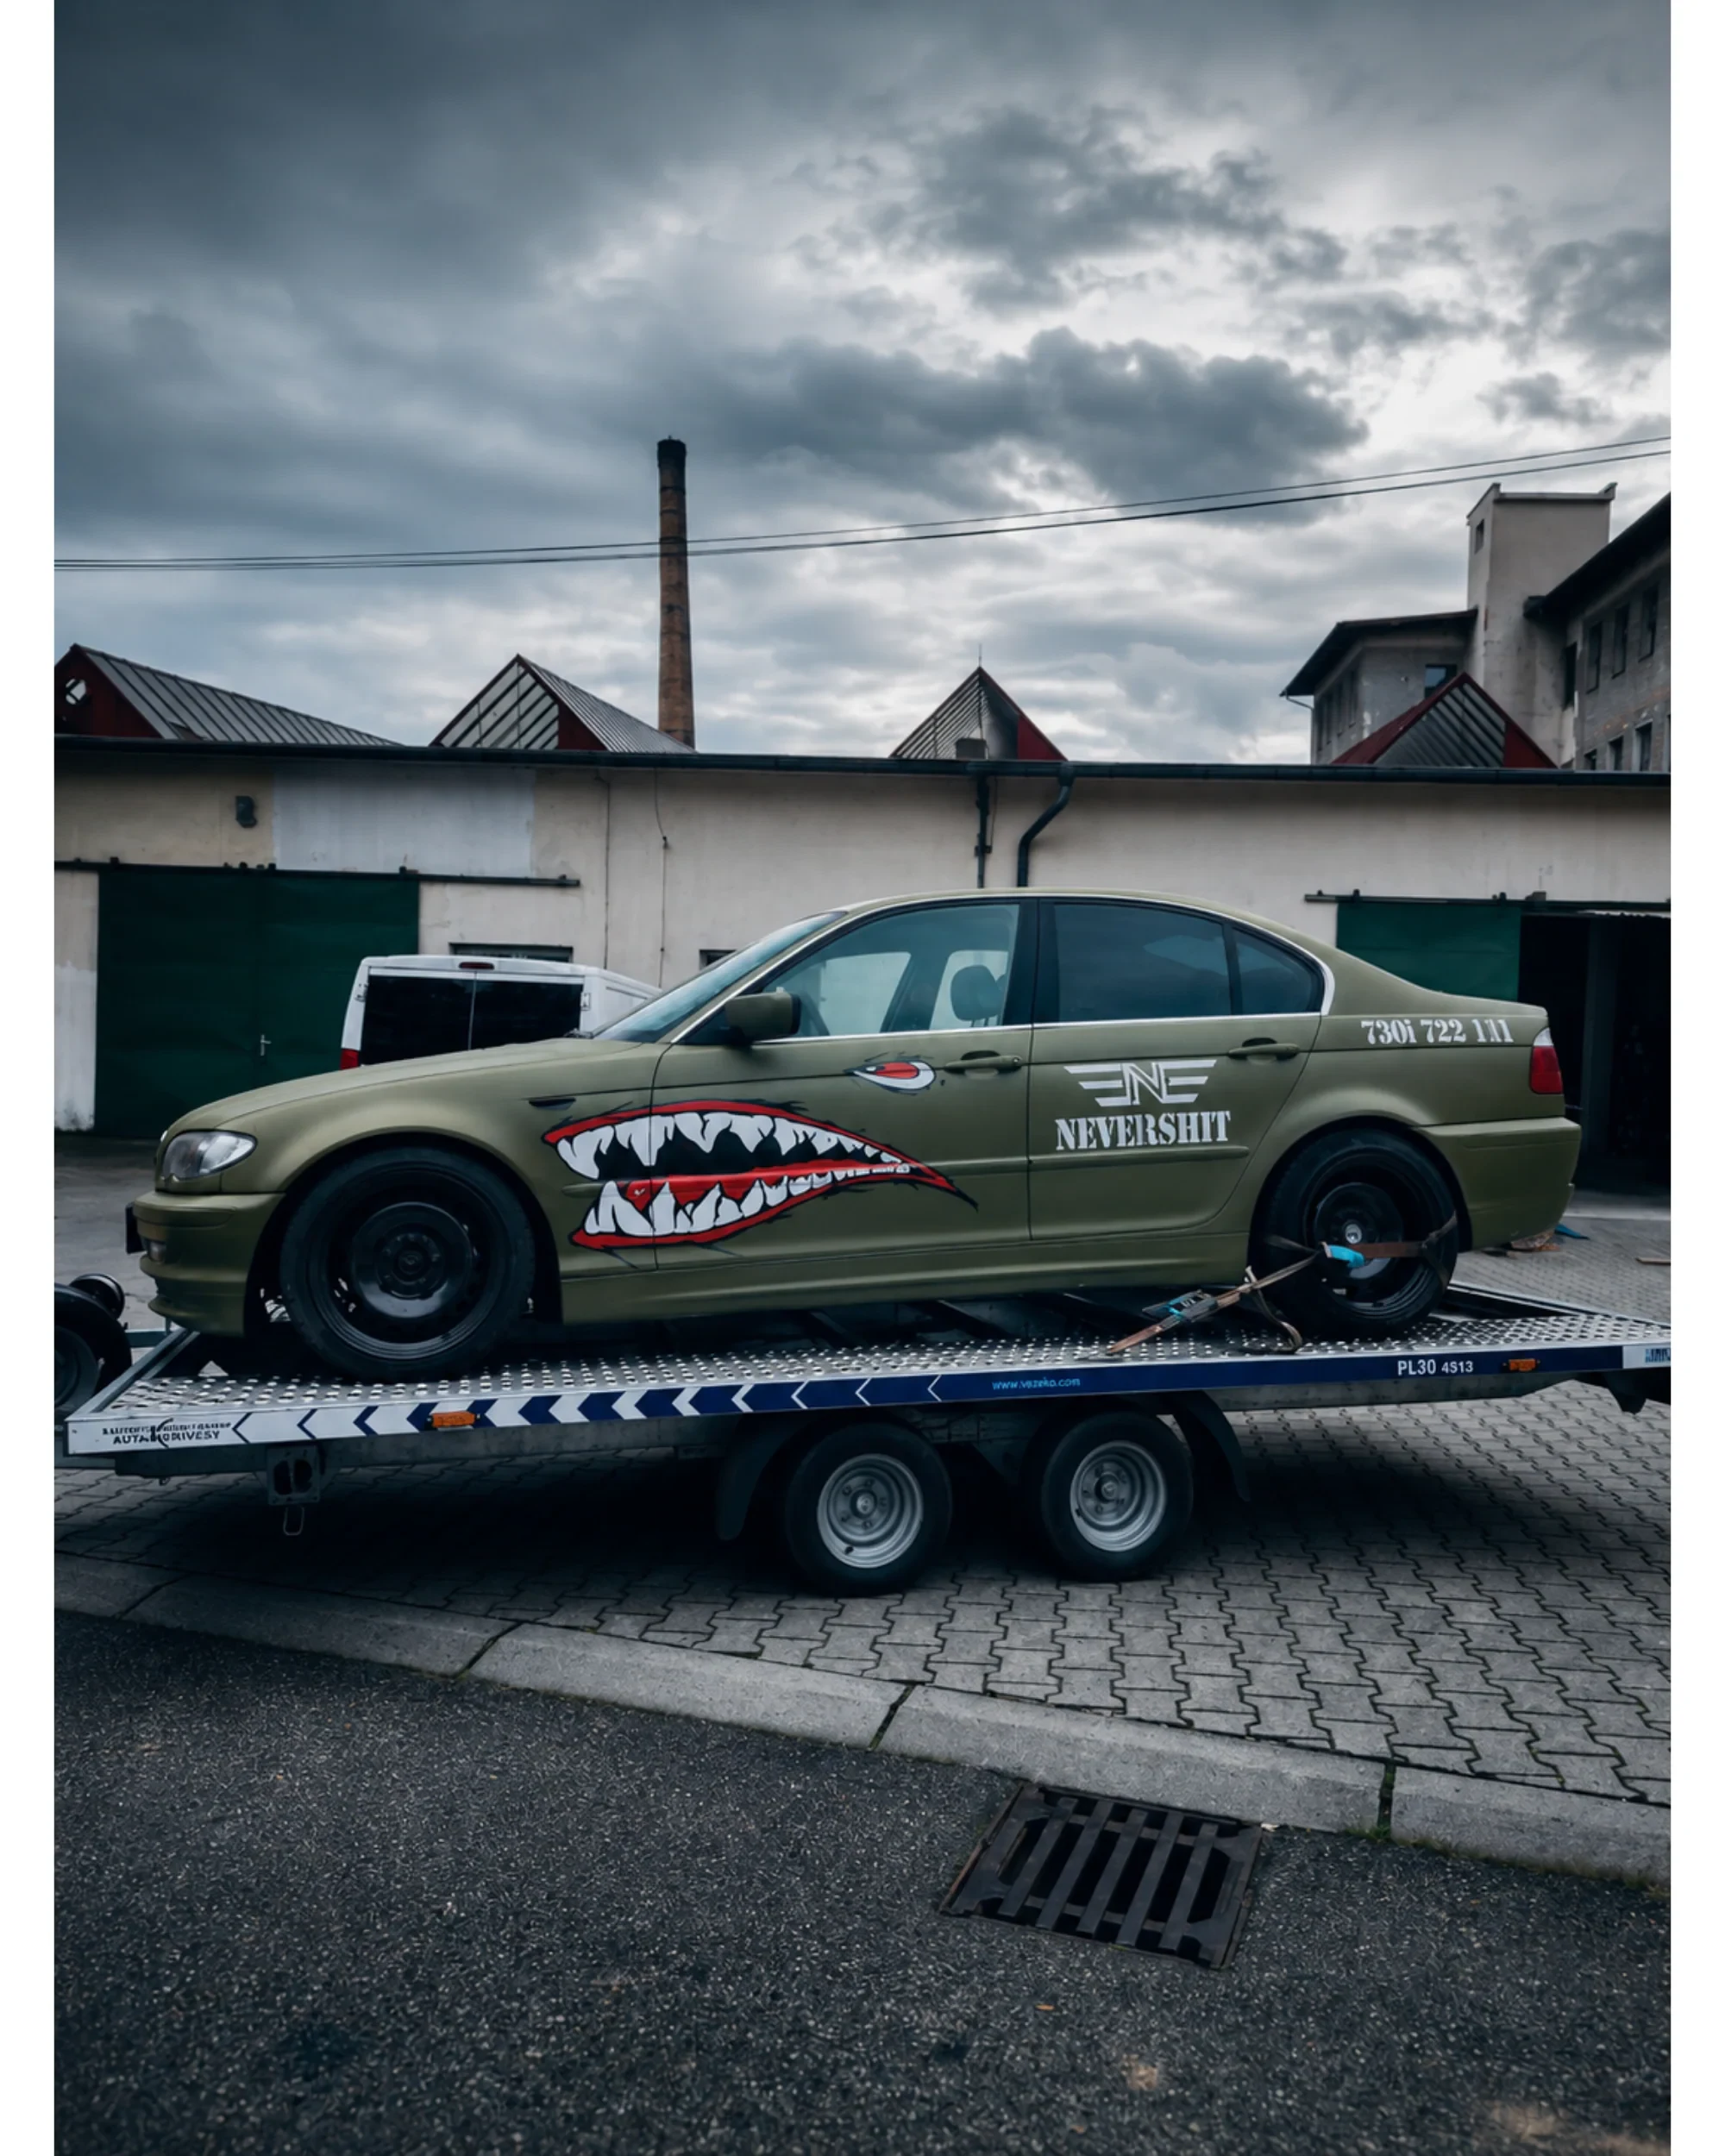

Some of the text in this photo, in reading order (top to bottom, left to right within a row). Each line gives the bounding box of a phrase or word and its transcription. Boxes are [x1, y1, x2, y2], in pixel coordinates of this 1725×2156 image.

[1421, 1018, 1466, 1043] 722
[1055, 1110, 1232, 1150] NEVERSHIT
[1397, 1359, 1436, 1376] PL30
